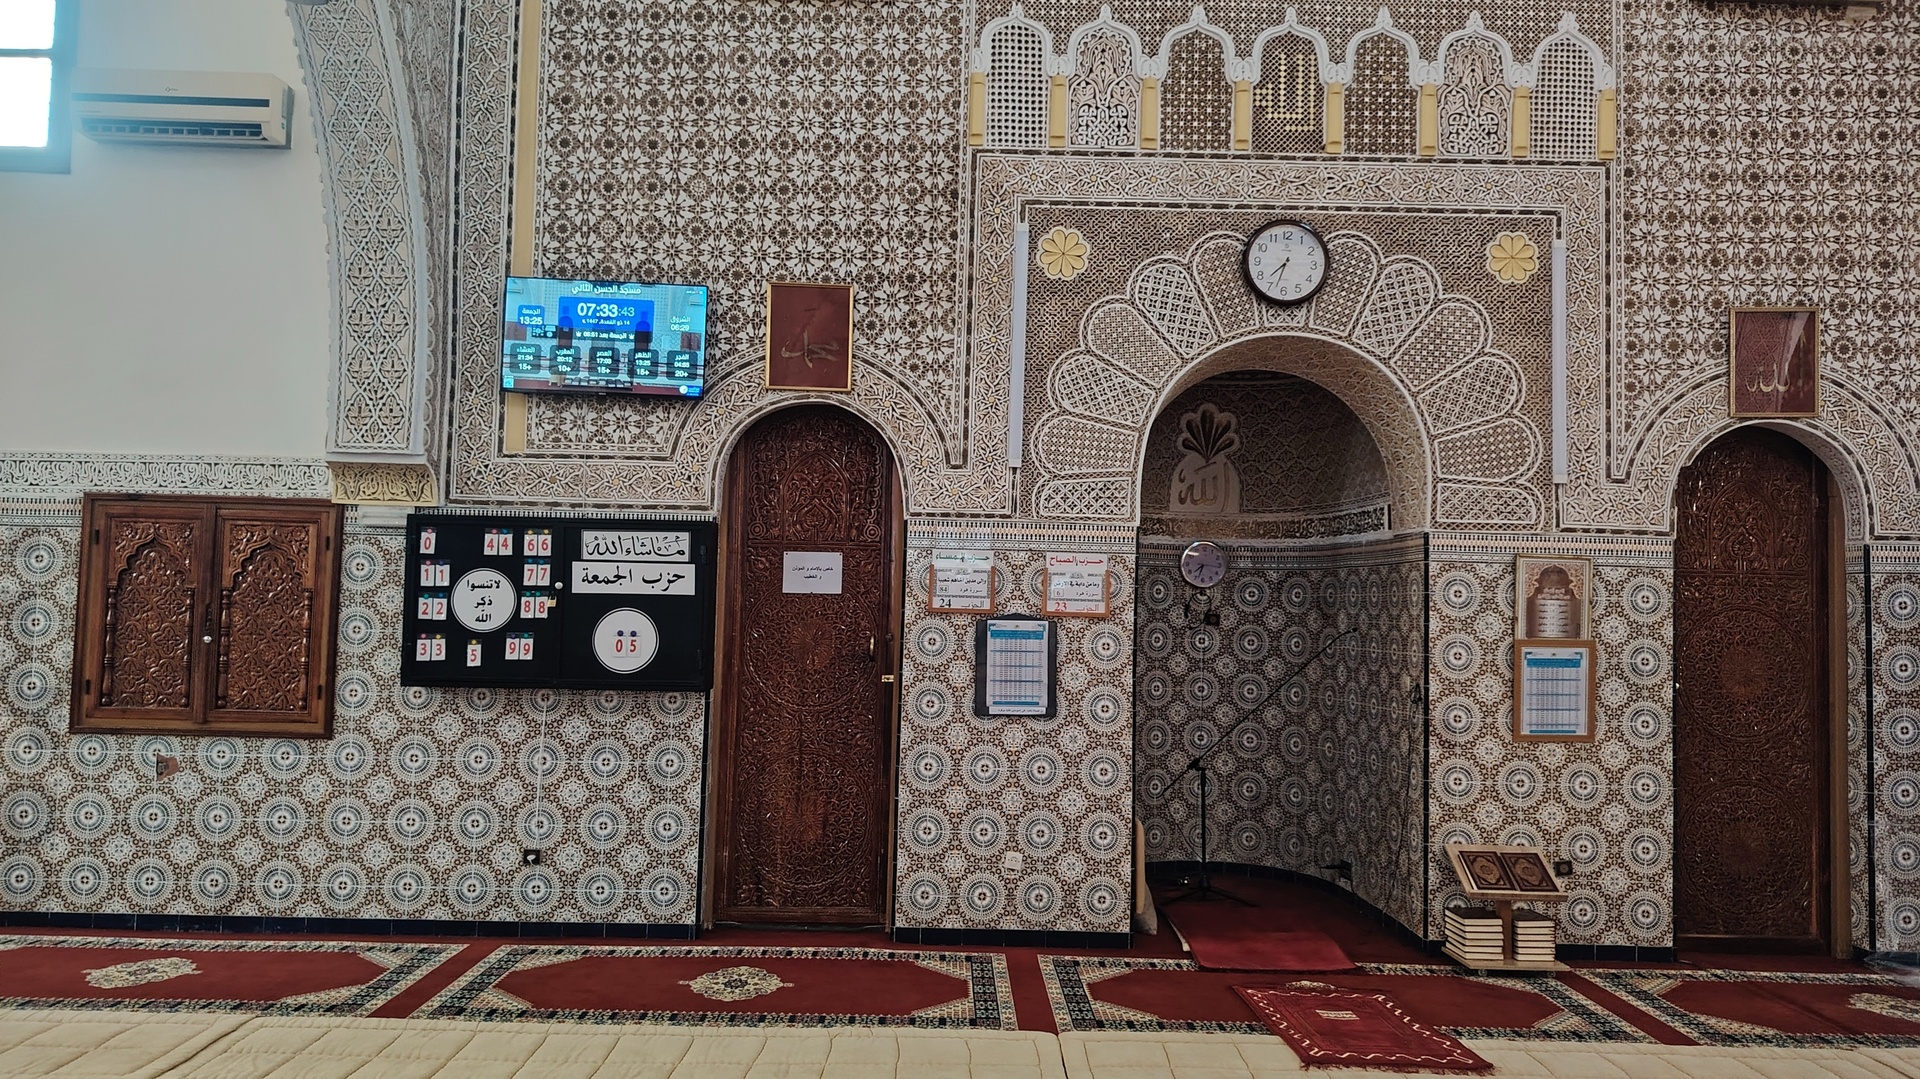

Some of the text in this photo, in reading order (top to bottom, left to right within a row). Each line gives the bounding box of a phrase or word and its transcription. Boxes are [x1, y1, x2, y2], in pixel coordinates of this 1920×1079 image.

[1269, 233, 1278, 243] 11
[1282, 230, 1293, 241] 12
[1299, 235, 1304, 245] 1
[1257, 242, 1268, 253] 10
[1307, 246, 1315, 256] 2
[1253, 256, 1262, 266] 9
[1309, 260, 1318, 270] 3
[1256, 270, 1264, 281] 8
[1305, 274, 1313, 284] 4
[571, 283, 642, 295] مسجد الحسن الثاني
[1266, 281, 1274, 292] 7
[1280, 286, 1288, 297] 6
[1294, 283, 1302, 294] 5
[519, 316, 543, 325] 13:25
[424, 536, 432, 551] 0
[1049, 555, 1104, 567] حزب الصباح
[581, 564, 686, 592] حزب الجمعة
[473, 595, 493, 609] ذكر
[938, 598, 952, 608] 24
[1054, 601, 1067, 612] 23
[475, 610, 492, 623] الله
[470, 648, 478, 663] 5
